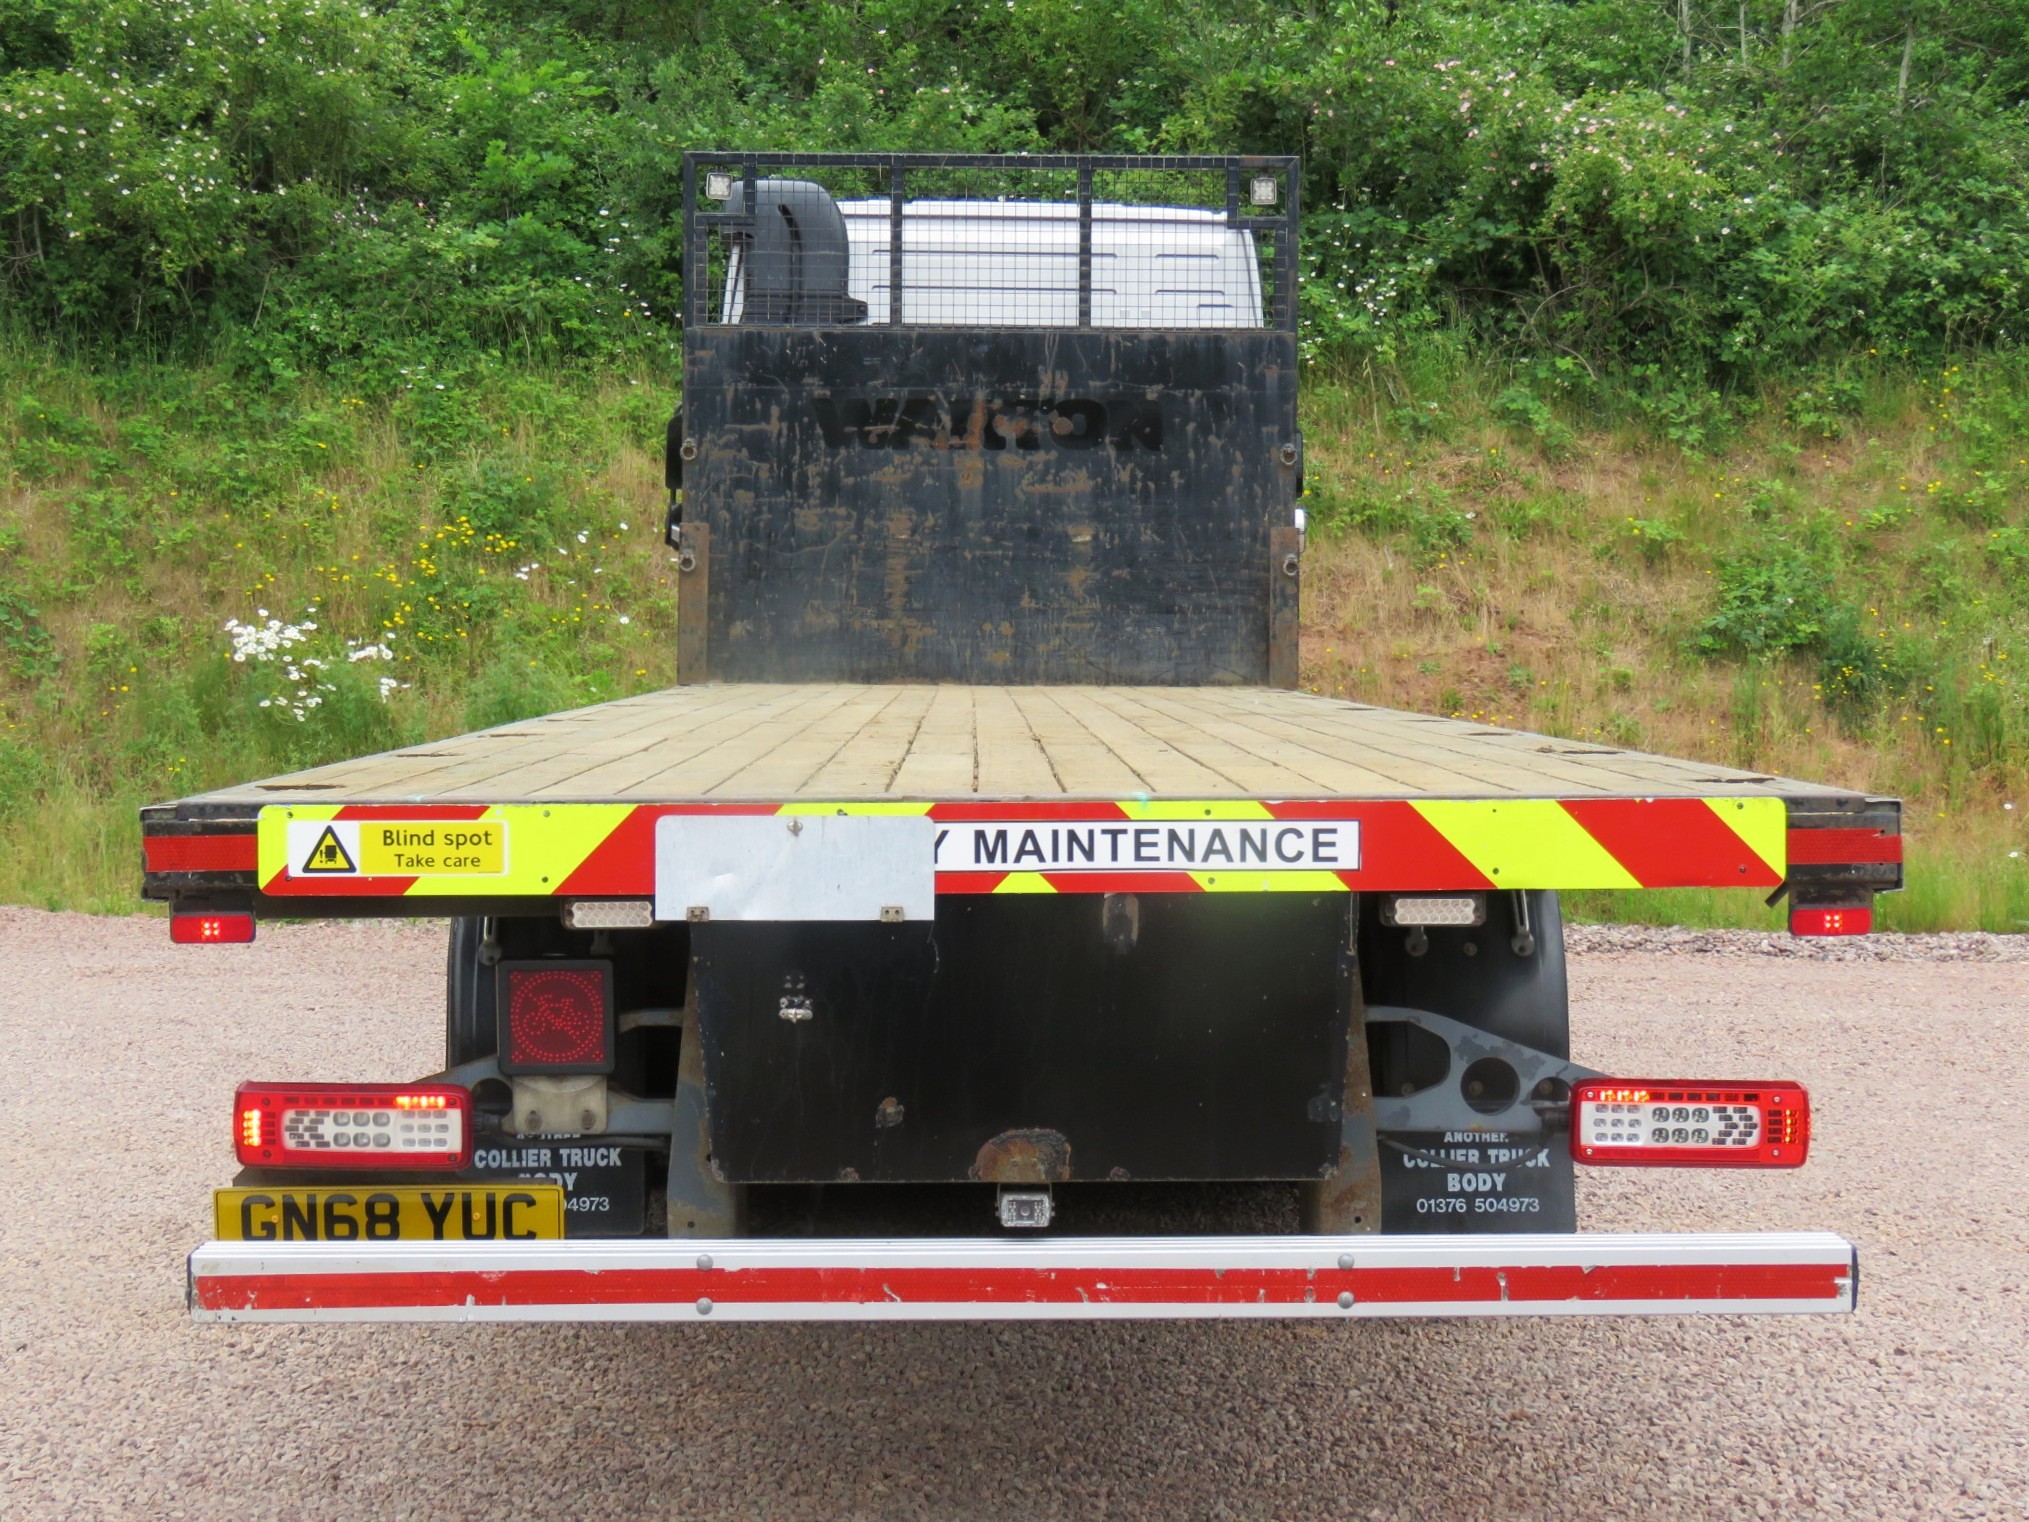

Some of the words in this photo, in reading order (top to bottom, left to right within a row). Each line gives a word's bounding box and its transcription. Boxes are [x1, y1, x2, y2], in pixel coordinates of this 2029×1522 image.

[382, 829, 435, 846] Blind
[443, 830, 493, 850] spot
[974, 827, 1339, 866] MAINTENANCE
[394, 853, 436, 867] Take
[442, 856, 481, 867] care
[474, 1148, 552, 1169] COLLIER
[559, 1147, 622, 1168] TRUCK
[1447, 1172, 1507, 1192] BODY
[1416, 1198, 1467, 1213] 01376
[1474, 1197, 1540, 1213] 504973
[240, 1193, 400, 1241] GN68
[420, 1192, 537, 1241] YUC
